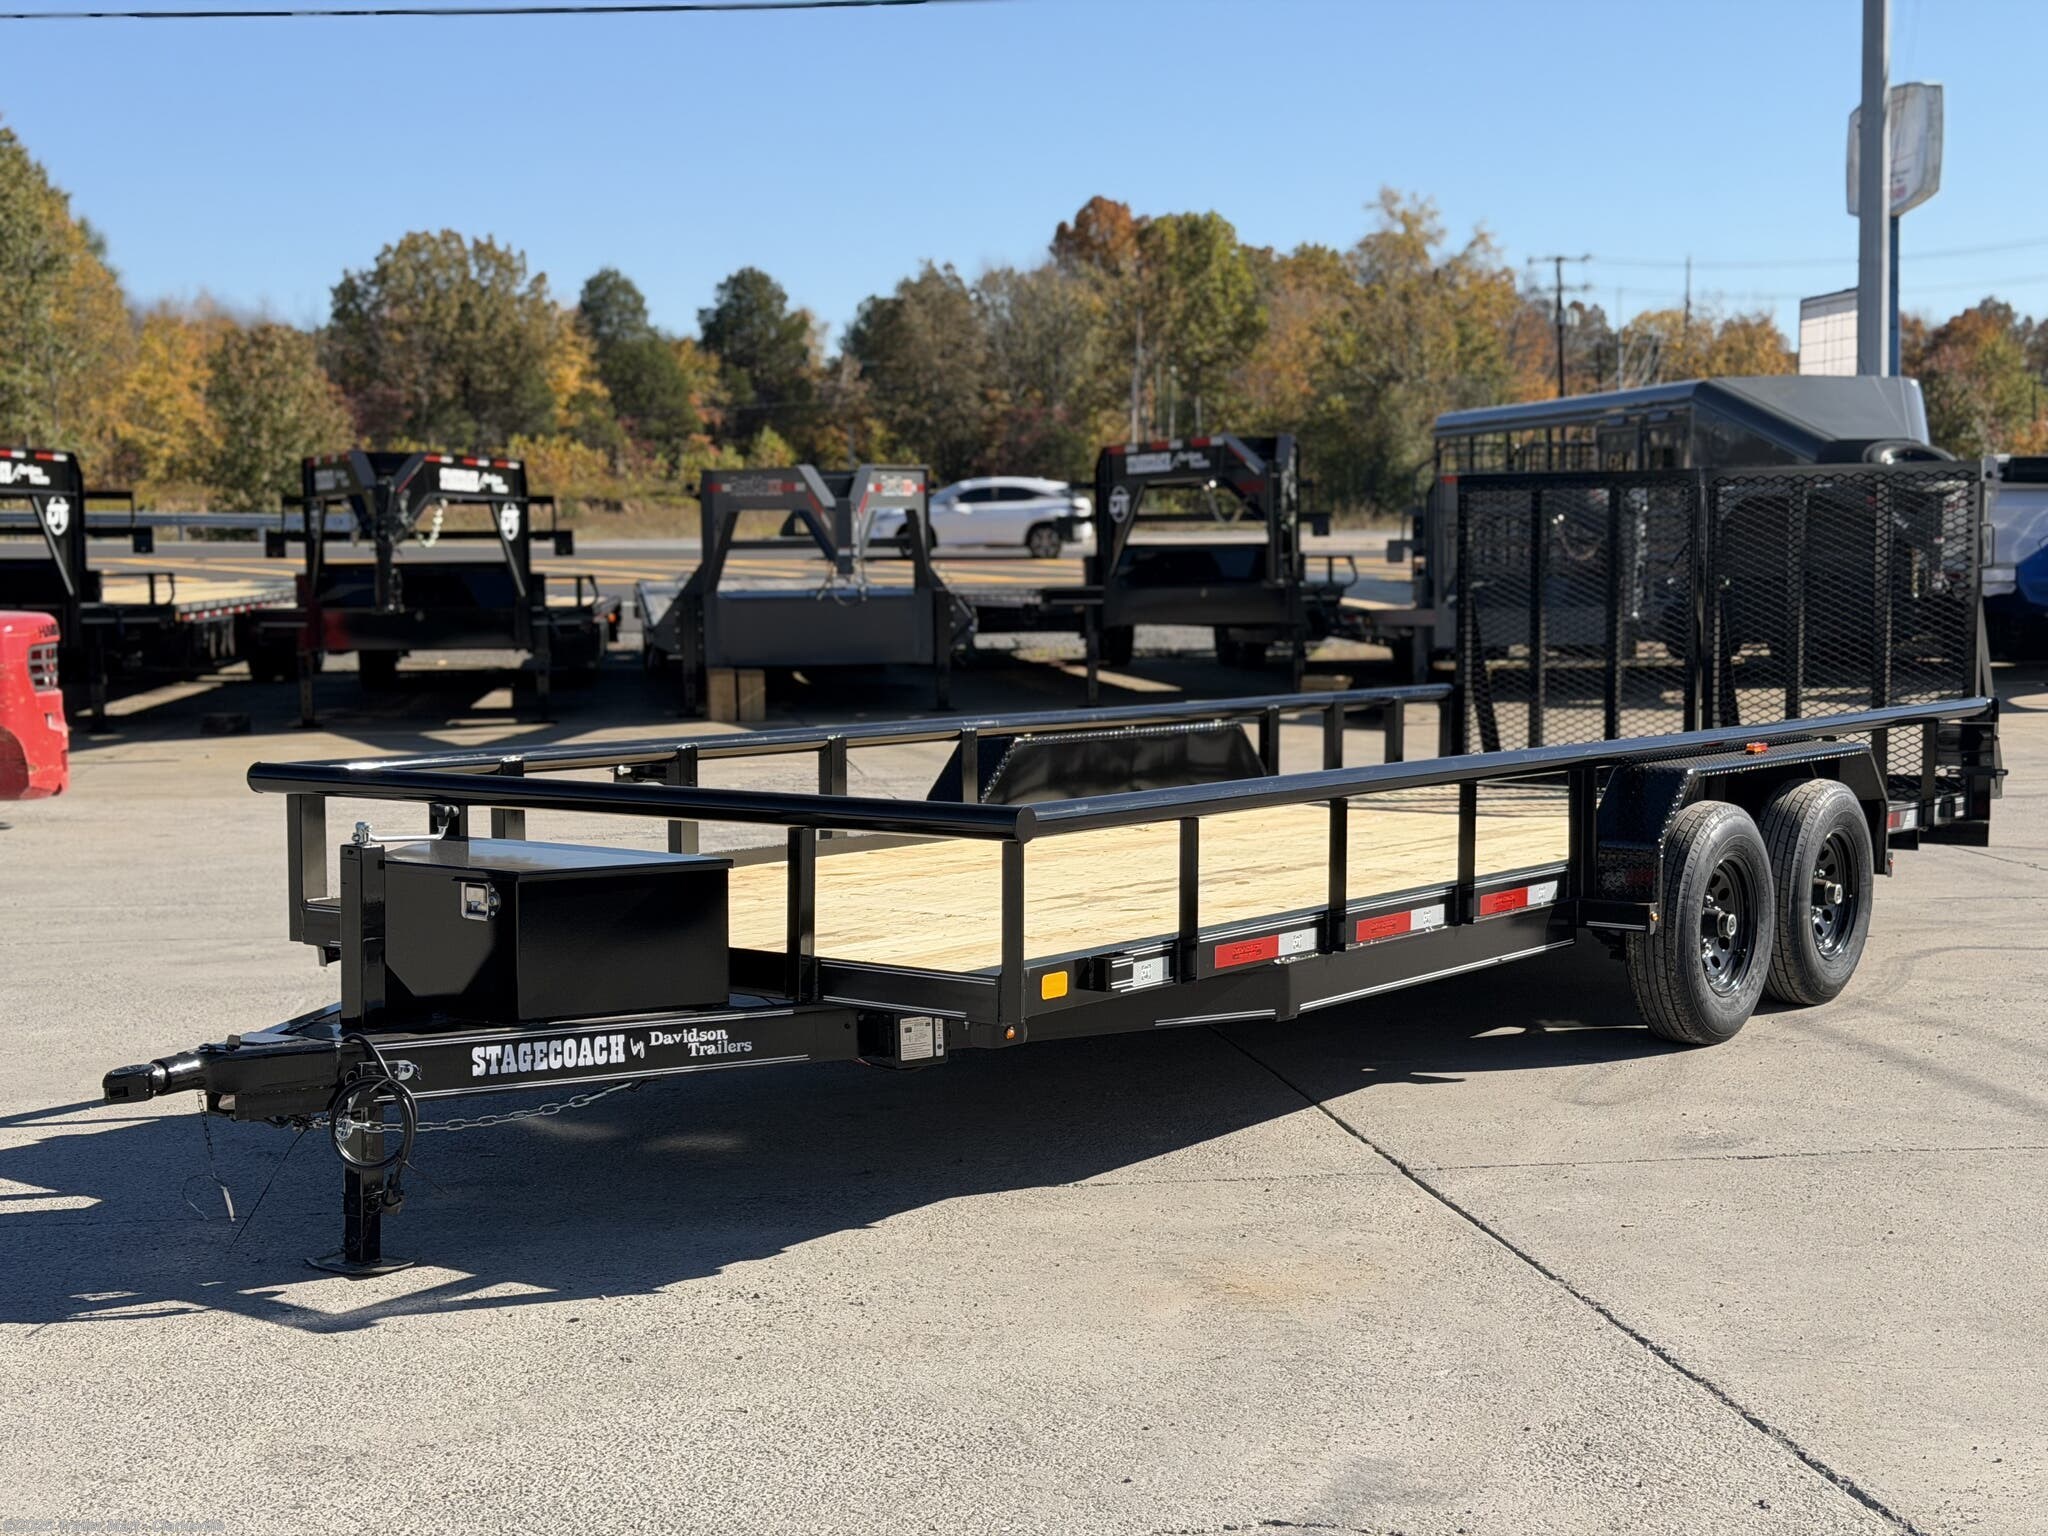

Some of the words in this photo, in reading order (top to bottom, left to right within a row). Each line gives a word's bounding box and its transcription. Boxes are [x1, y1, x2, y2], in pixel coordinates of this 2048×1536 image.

[472, 1034, 625, 1076] STAGECOACH
[630, 1038, 645, 1059] by
[649, 1028, 728, 1046] Davidson
[688, 1041, 753, 1057] Trailers
